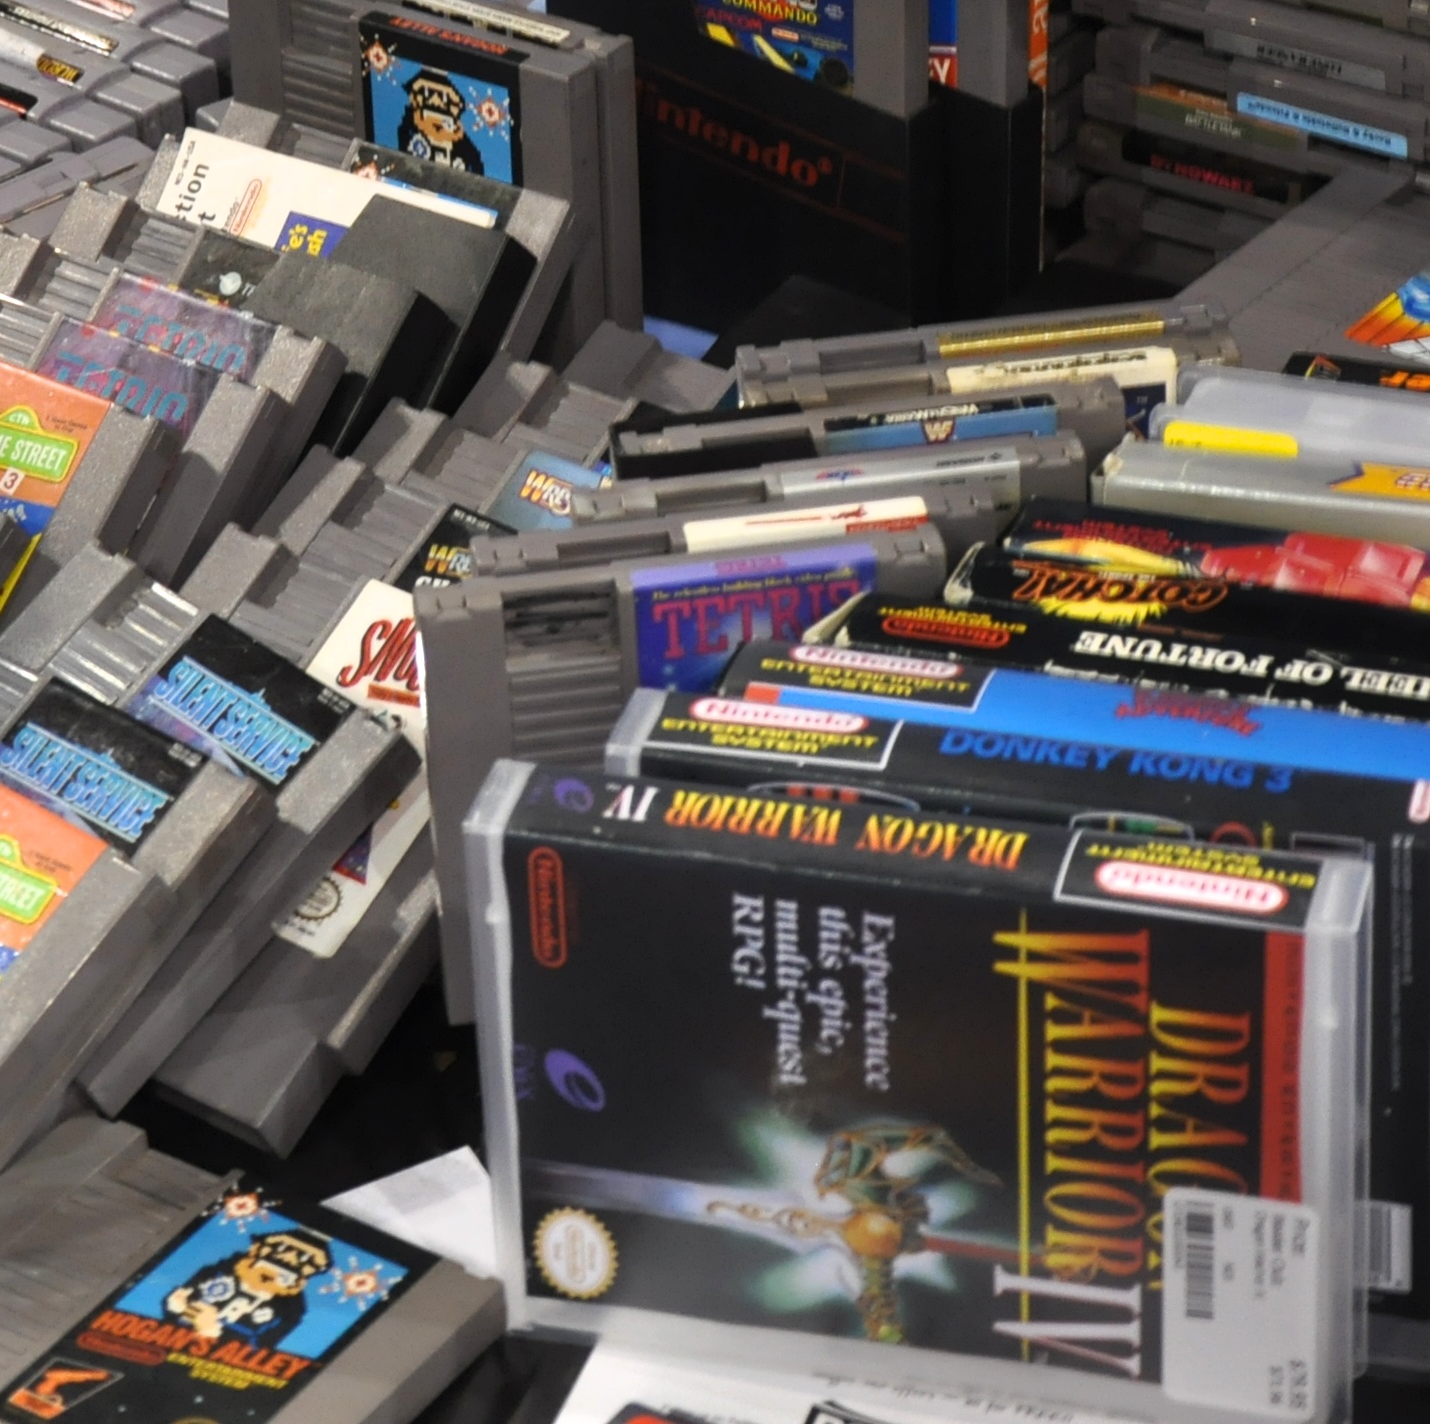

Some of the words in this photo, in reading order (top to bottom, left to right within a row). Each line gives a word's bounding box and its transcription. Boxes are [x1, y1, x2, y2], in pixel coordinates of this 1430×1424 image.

[695, 5, 764, 33] CAPCOM
[10, 438, 69, 474] STREET
[759, 657, 971, 694] ENTERTAINMENT
[801, 647, 953, 674] Nintendo
[1074, 631, 1268, 679] FORTUNE
[1281, 659, 1332, 687] OF
[807, 673, 914, 698] SYSTEM
[154, 658, 232, 737] SILENT
[216, 697, 314, 780] SERVICE
[660, 716, 879, 749] ENTERTAINMENT
[703, 699, 855, 731] Nintendo
[711, 731, 820, 754] SYSTEM
[938, 729, 1119, 771] DONKEY
[1127, 751, 1258, 788] KONG
[1265, 767, 1294, 794] 3
[64, 766, 169, 838] SERVICE
[603, 784, 659, 824] IV
[664, 789, 843, 847] WARRIOR
[857, 814, 1030, 870] DRAGON
[1085, 840, 1318, 890] ENTERTAINMENT
[1105, 865, 1273, 908] Nintendo
[731, 892, 766, 990] RPG!
[817, 906, 855, 971] this
[763, 898, 812, 1088] multi-quest
[807, 979, 853, 1056] epic,
[850, 910, 897, 1092] Experience
[993, 928, 1149, 1278] WARRIOR
[993, 1264, 1142, 1377] IV
[90, 1309, 217, 1359] HOGAN'S
[213, 1337, 314, 1382] ALLEY
[166, 1353, 288, 1390] ENTERTAINMENT
[191, 1369, 252, 1391] SYSTEM
